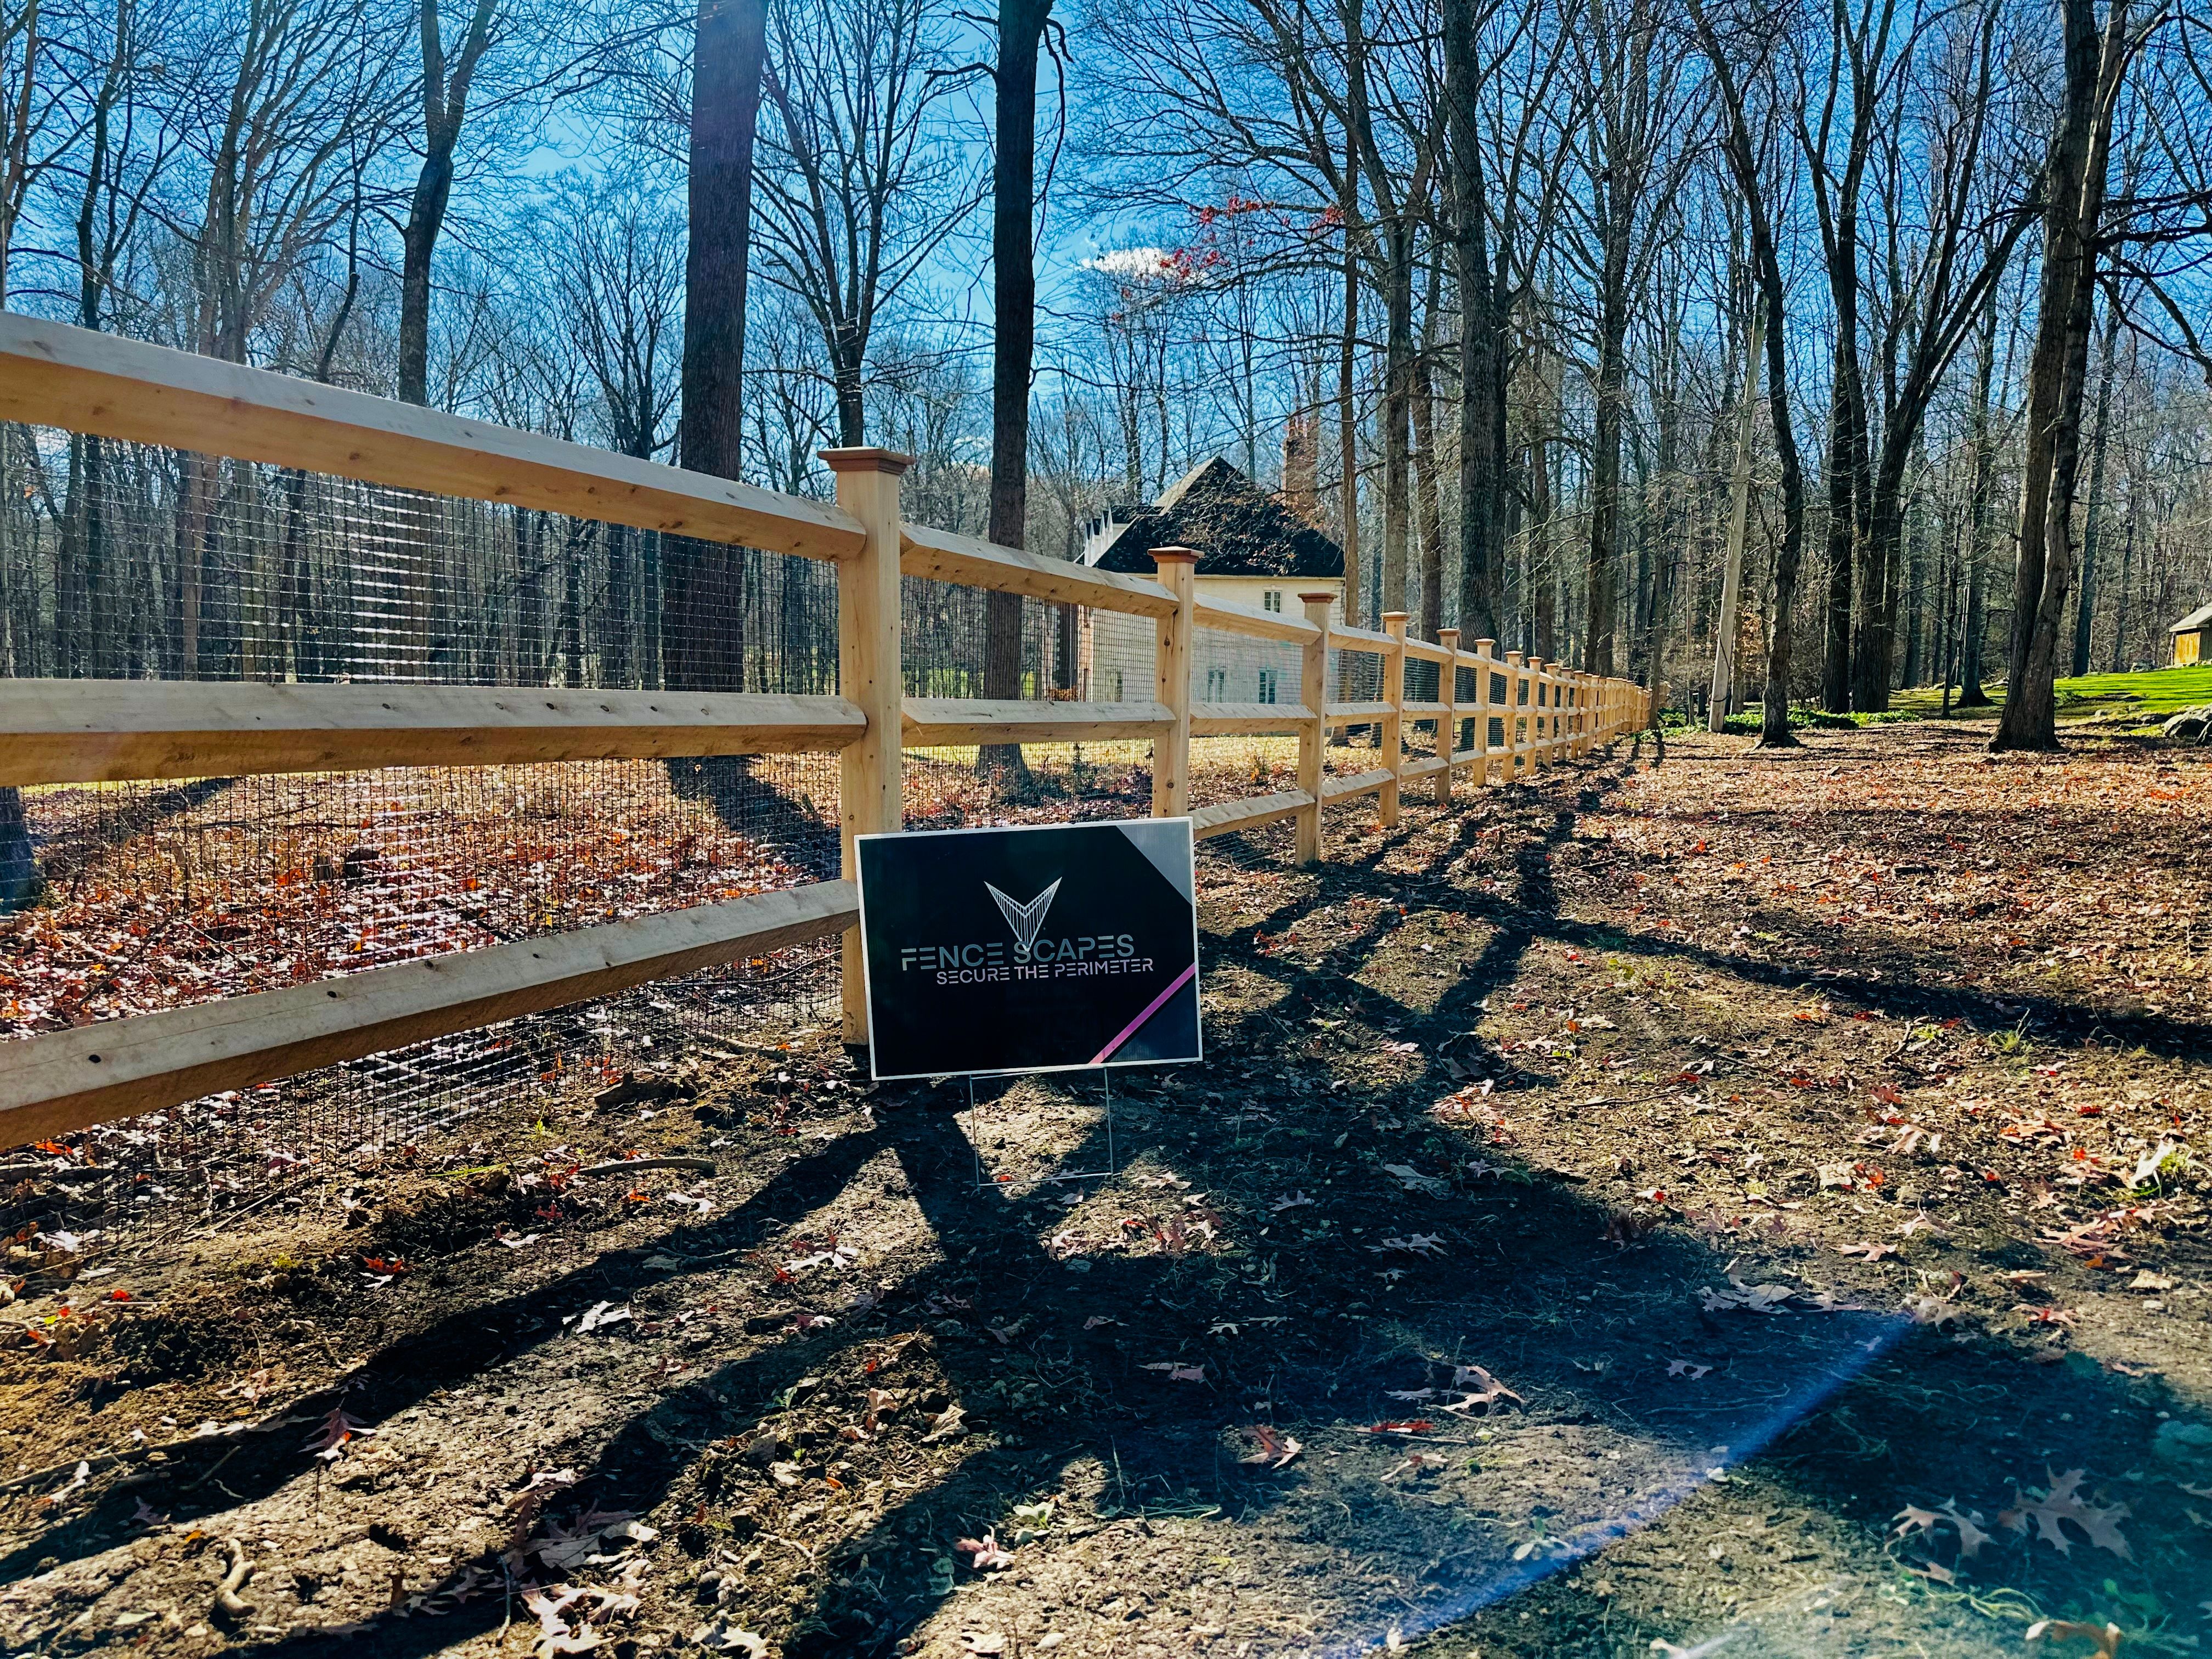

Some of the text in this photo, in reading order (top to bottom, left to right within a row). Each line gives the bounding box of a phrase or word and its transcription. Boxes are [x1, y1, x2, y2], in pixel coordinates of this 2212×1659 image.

[901, 934, 1134, 971] FENCE SCAPES
[936, 958, 1153, 985] SECURE THE PERIMETER
